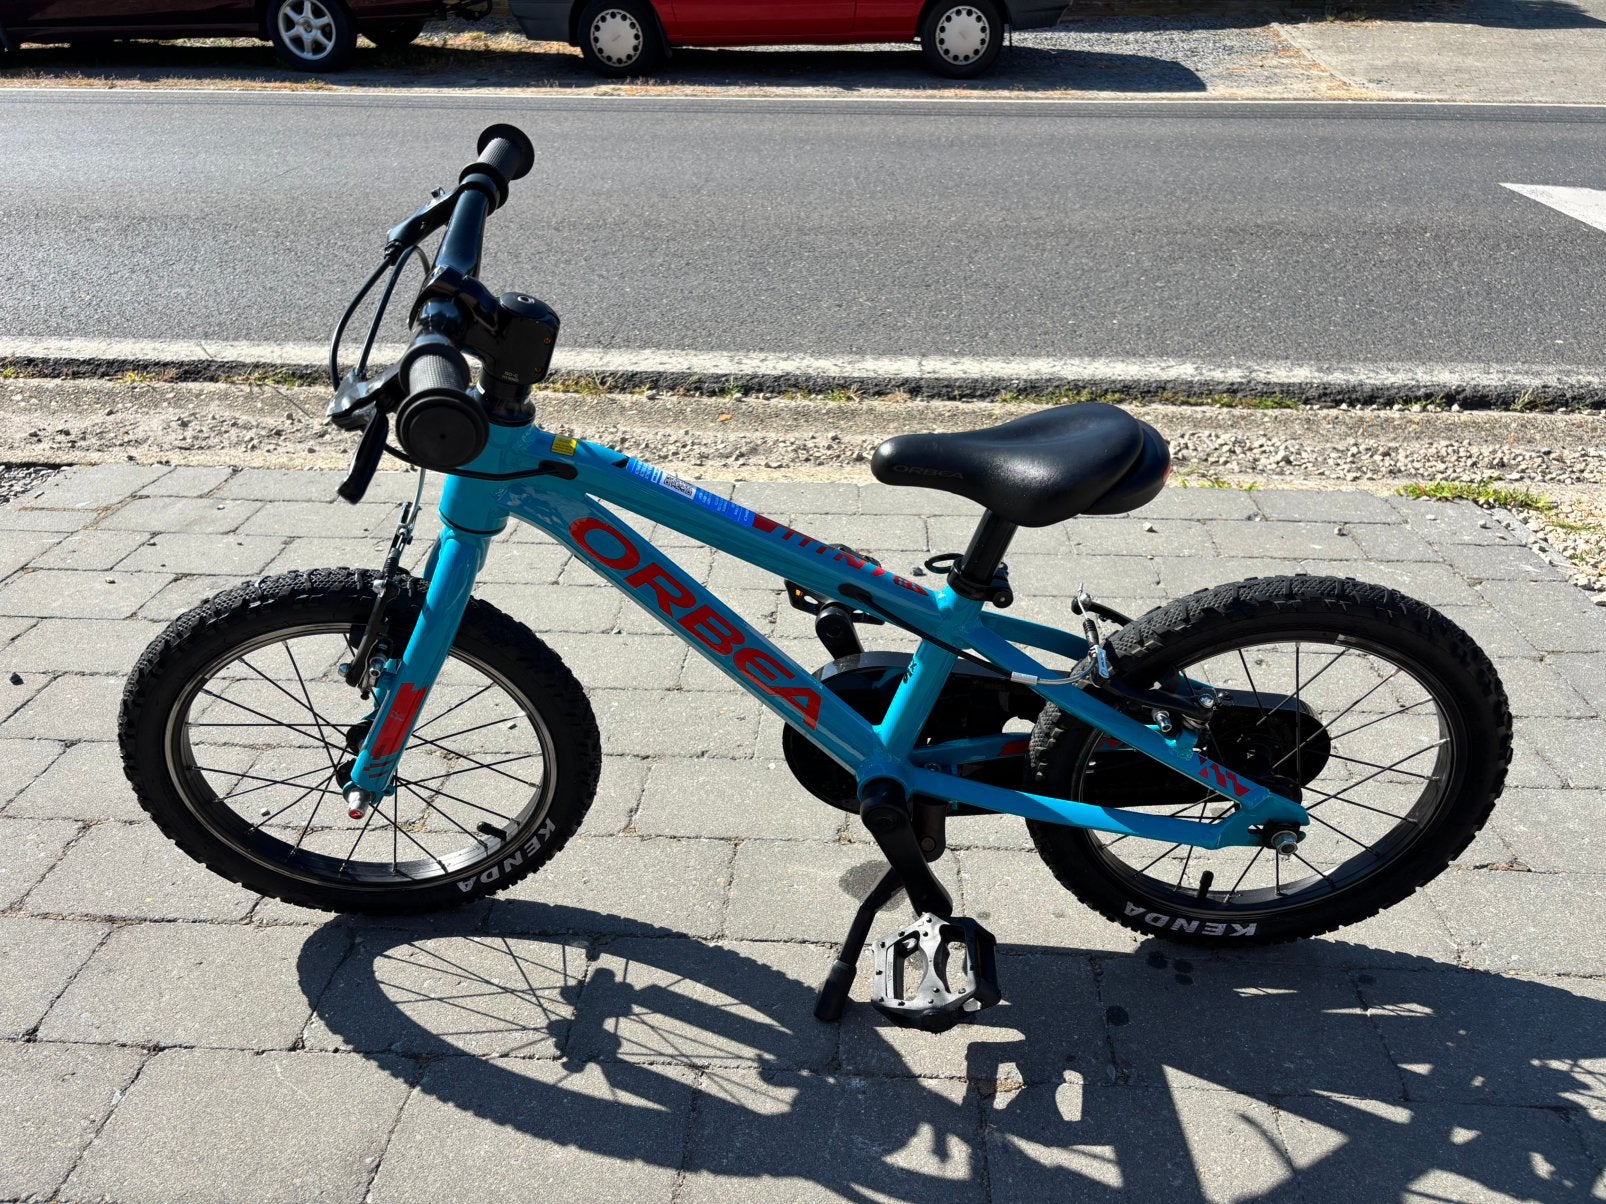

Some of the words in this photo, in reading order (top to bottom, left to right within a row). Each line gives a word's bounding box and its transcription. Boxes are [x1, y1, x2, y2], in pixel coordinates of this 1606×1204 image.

[892, 464, 964, 481] ORBEA
[568, 517, 823, 731] ORBEA
[456, 817, 556, 893] KENDA
[1123, 901, 1258, 937] KENDA
